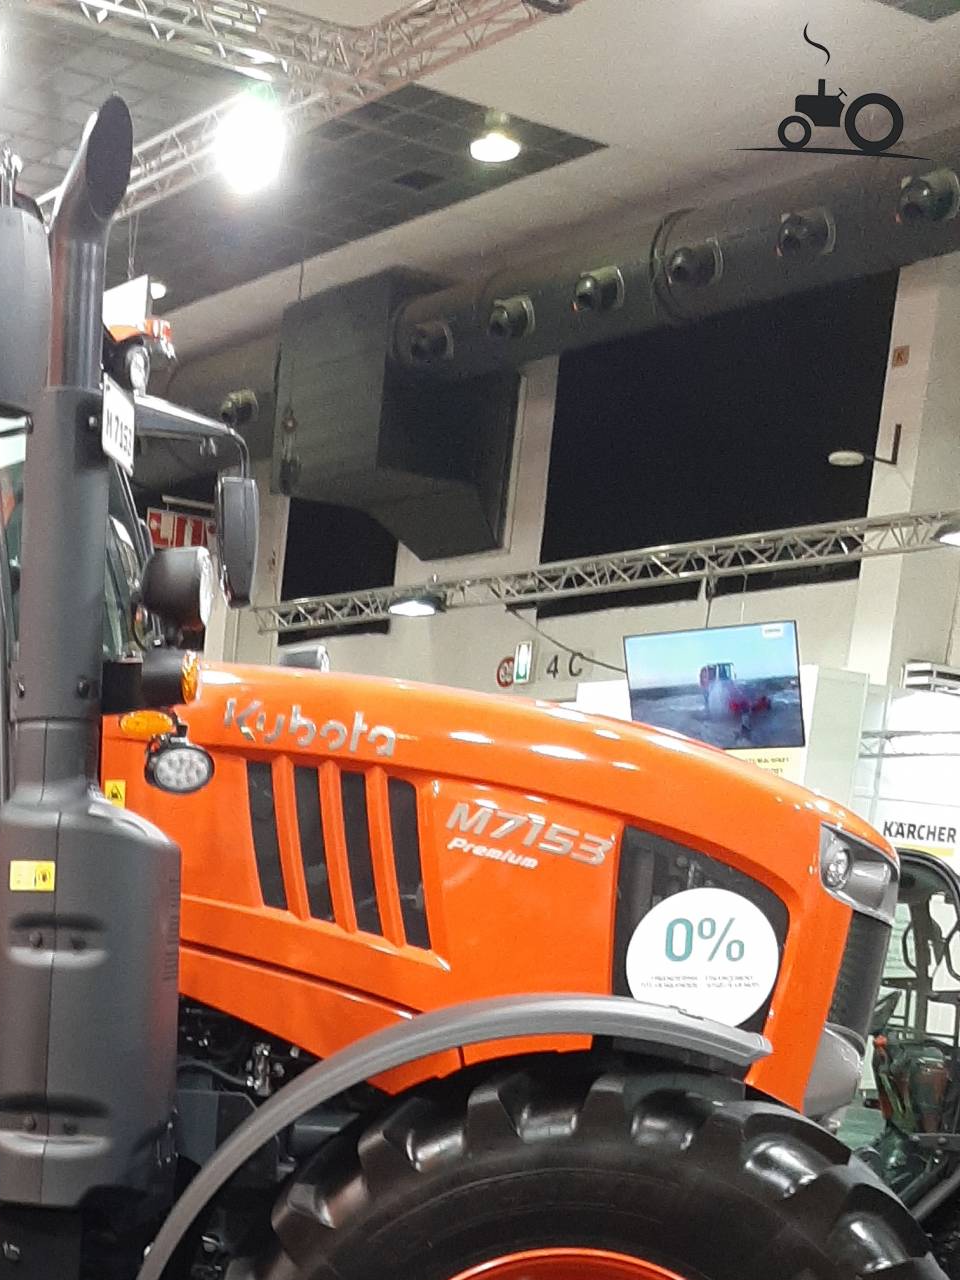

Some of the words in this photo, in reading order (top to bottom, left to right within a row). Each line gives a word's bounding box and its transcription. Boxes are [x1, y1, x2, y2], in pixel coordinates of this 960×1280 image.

[224, 697, 397, 758] Kubota
[445, 802, 616, 866] M7153
[447, 837, 538, 869] Premium
[883, 820, 957, 843] KÄRCHER
[665, 917, 745, 962] 0%
